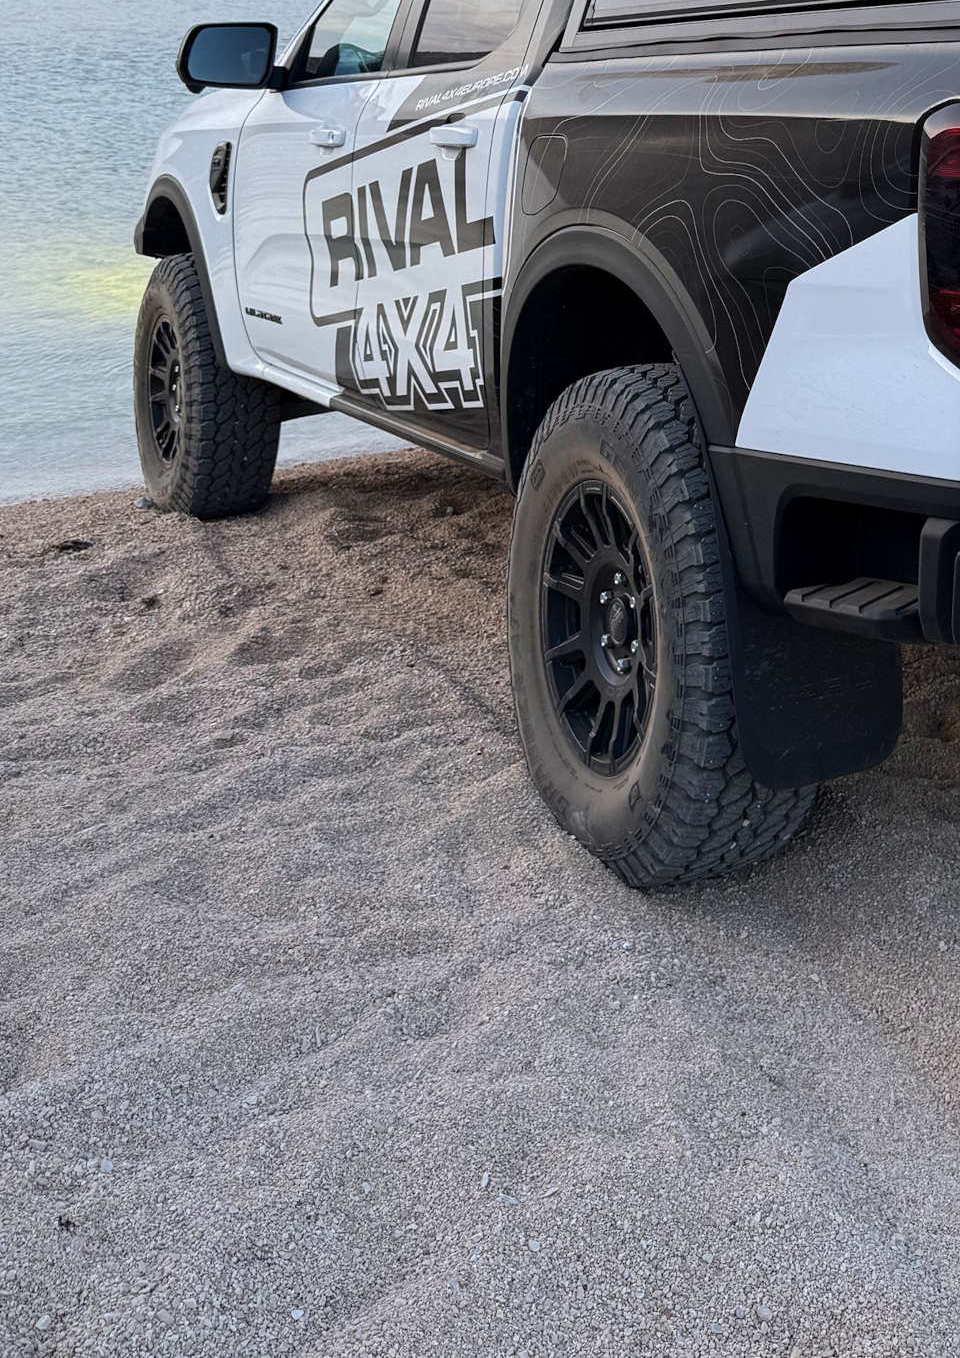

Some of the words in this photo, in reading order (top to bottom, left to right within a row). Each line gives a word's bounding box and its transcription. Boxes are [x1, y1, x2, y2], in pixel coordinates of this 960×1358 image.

[415, 63, 529, 111] RIVAL4X4EUROPE.COM
[322, 148, 496, 288] RIVAL
[355, 288, 482, 408] 4X4
